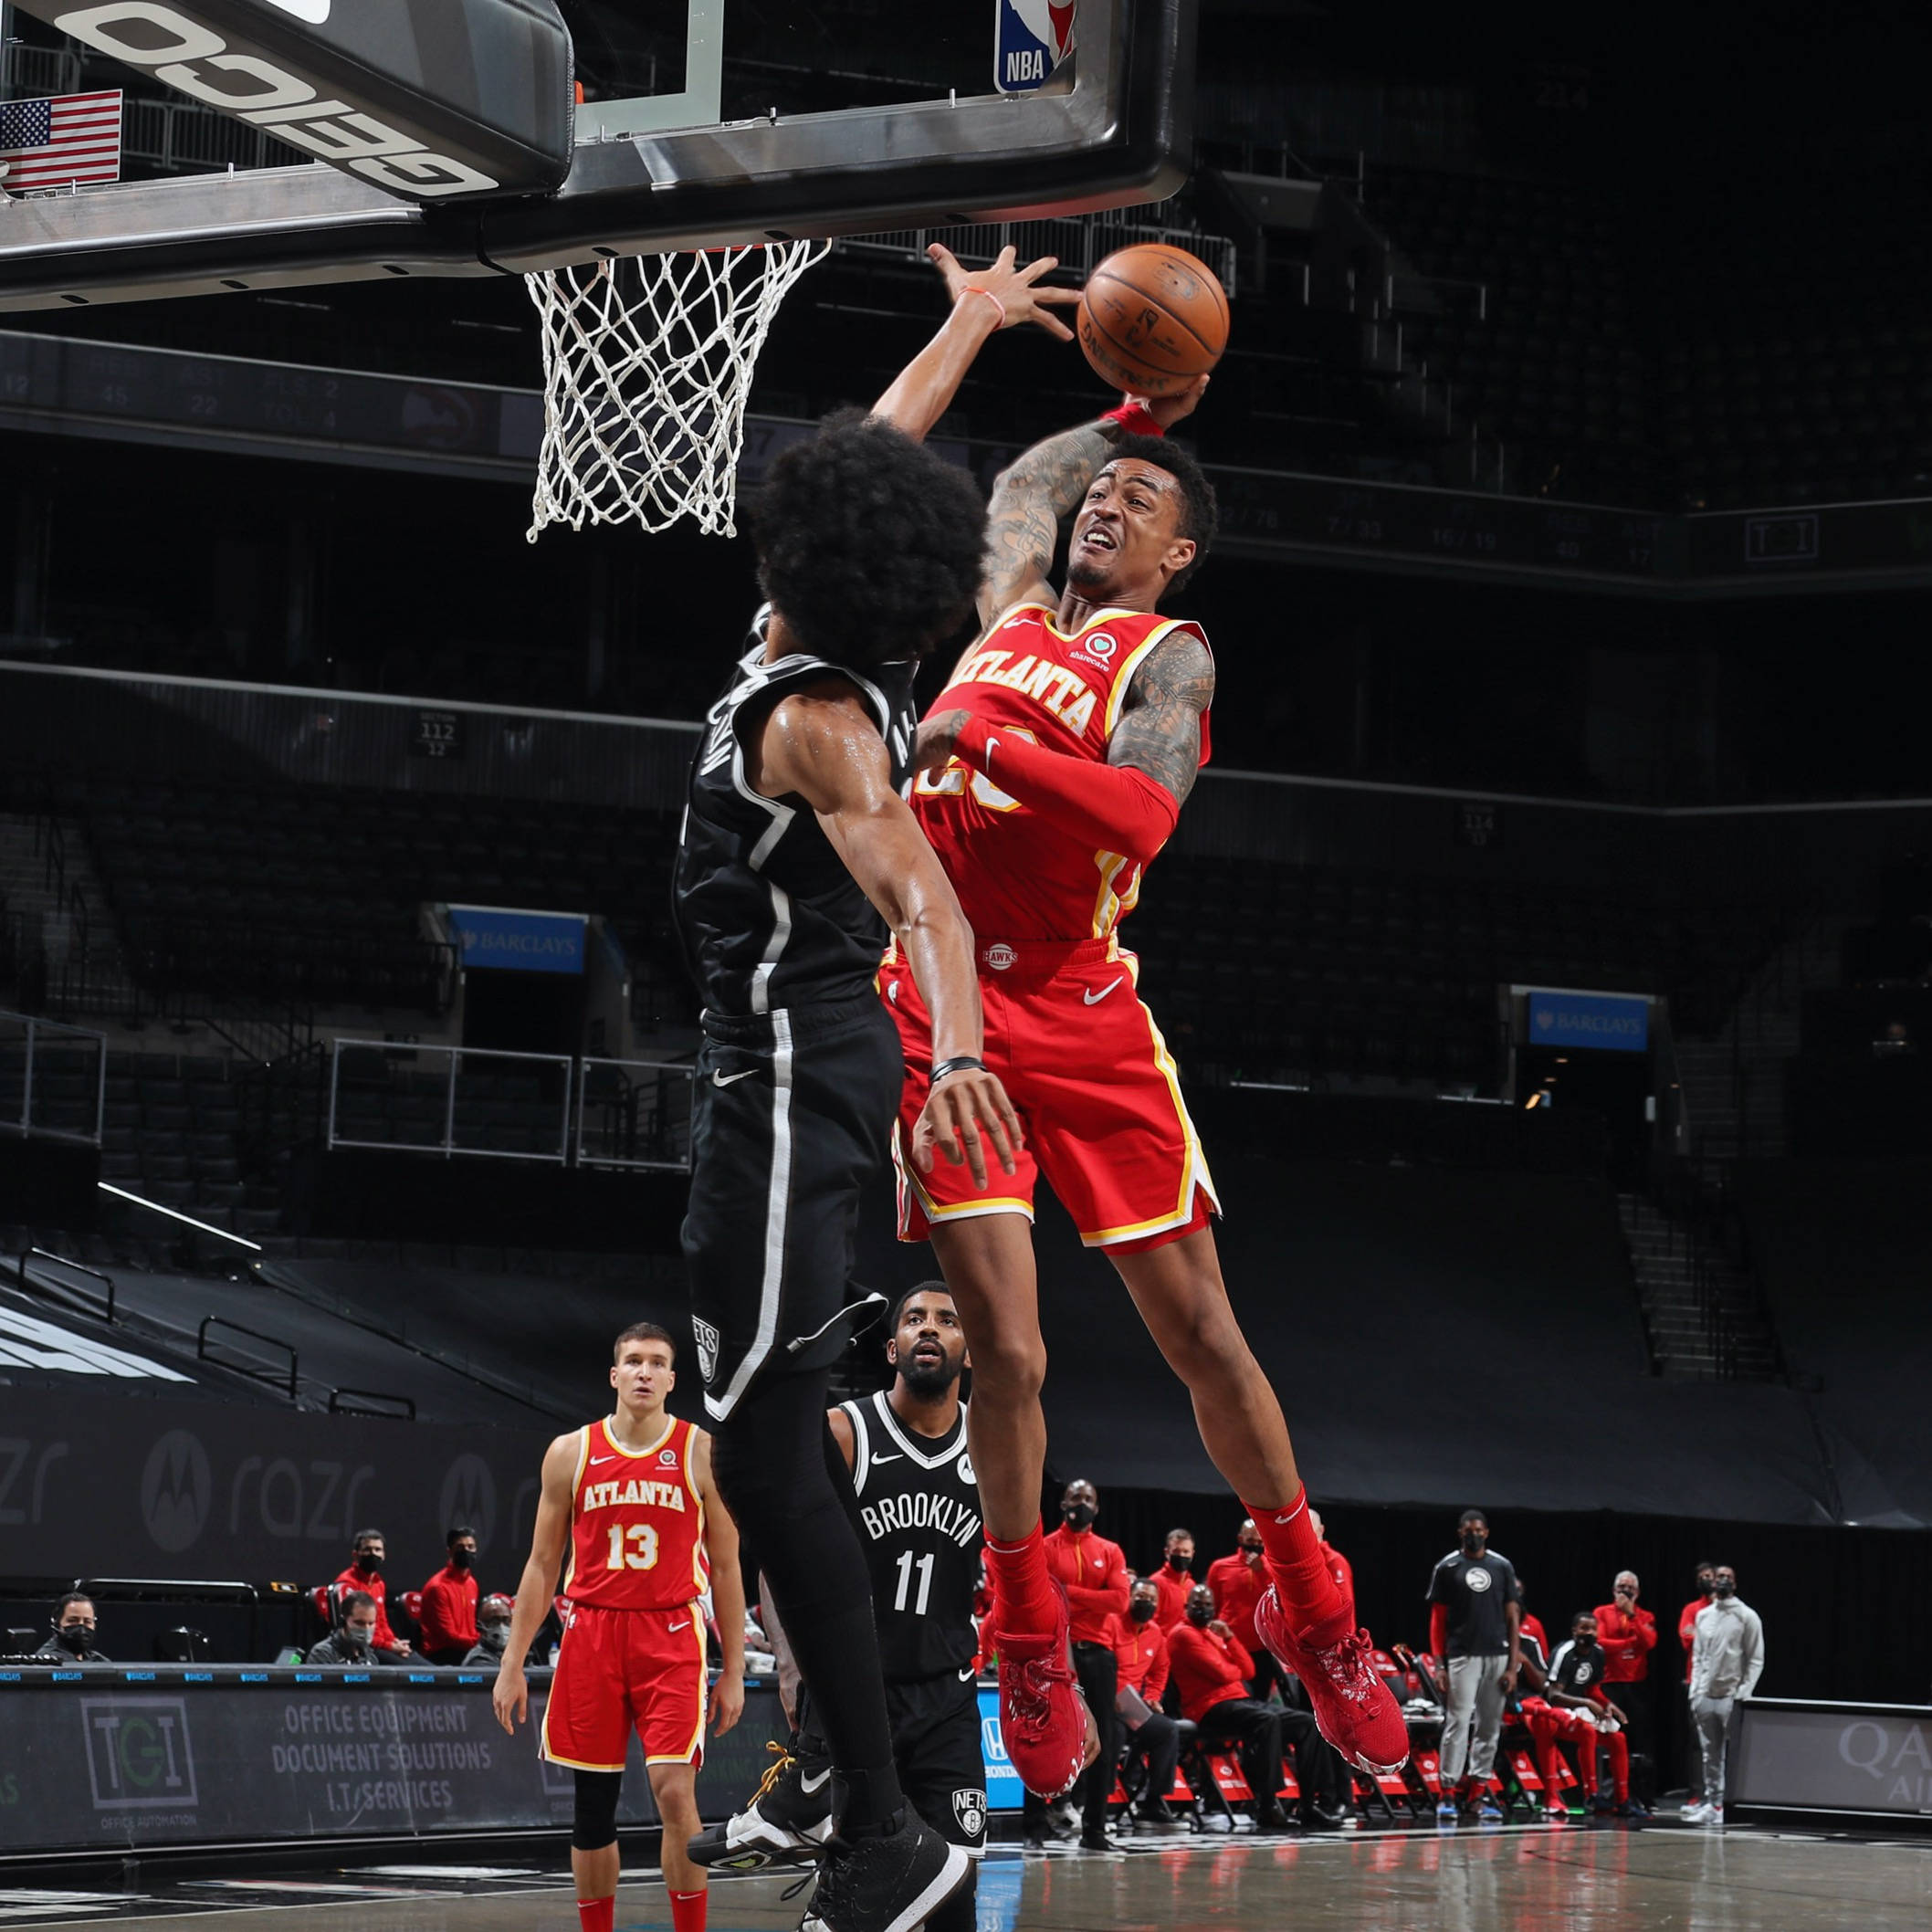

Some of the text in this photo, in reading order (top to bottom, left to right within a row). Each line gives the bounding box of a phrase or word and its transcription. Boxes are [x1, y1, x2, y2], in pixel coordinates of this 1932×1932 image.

[1006, 49, 1045, 82] NBA
[53, 1, 500, 196] GEICO
[191, 394, 218, 415] 22
[1069, 651, 1110, 672] sharecare
[421, 722, 456, 740] 112
[481, 931, 577, 956] BARCLAYS
[982, 950, 1018, 963] HAWKS
[1558, 1013, 1642, 1035] BARCLAYS
[227, 1455, 377, 1541] razr
[583, 1479, 685, 1513] ATLANTA
[860, 1492, 982, 1548] BROOKLYN
[606, 1523, 658, 1570] 13
[894, 1550, 935, 1615] 11
[285, 1705, 467, 1738] OFFICE EQUIPMENT
[93, 1717, 183, 1790] TGI
[272, 1741, 492, 1773] DOCUMENT SOLUTIONS
[362, 1780, 453, 1811] SERVICES
[956, 1791, 987, 1812] NETS
